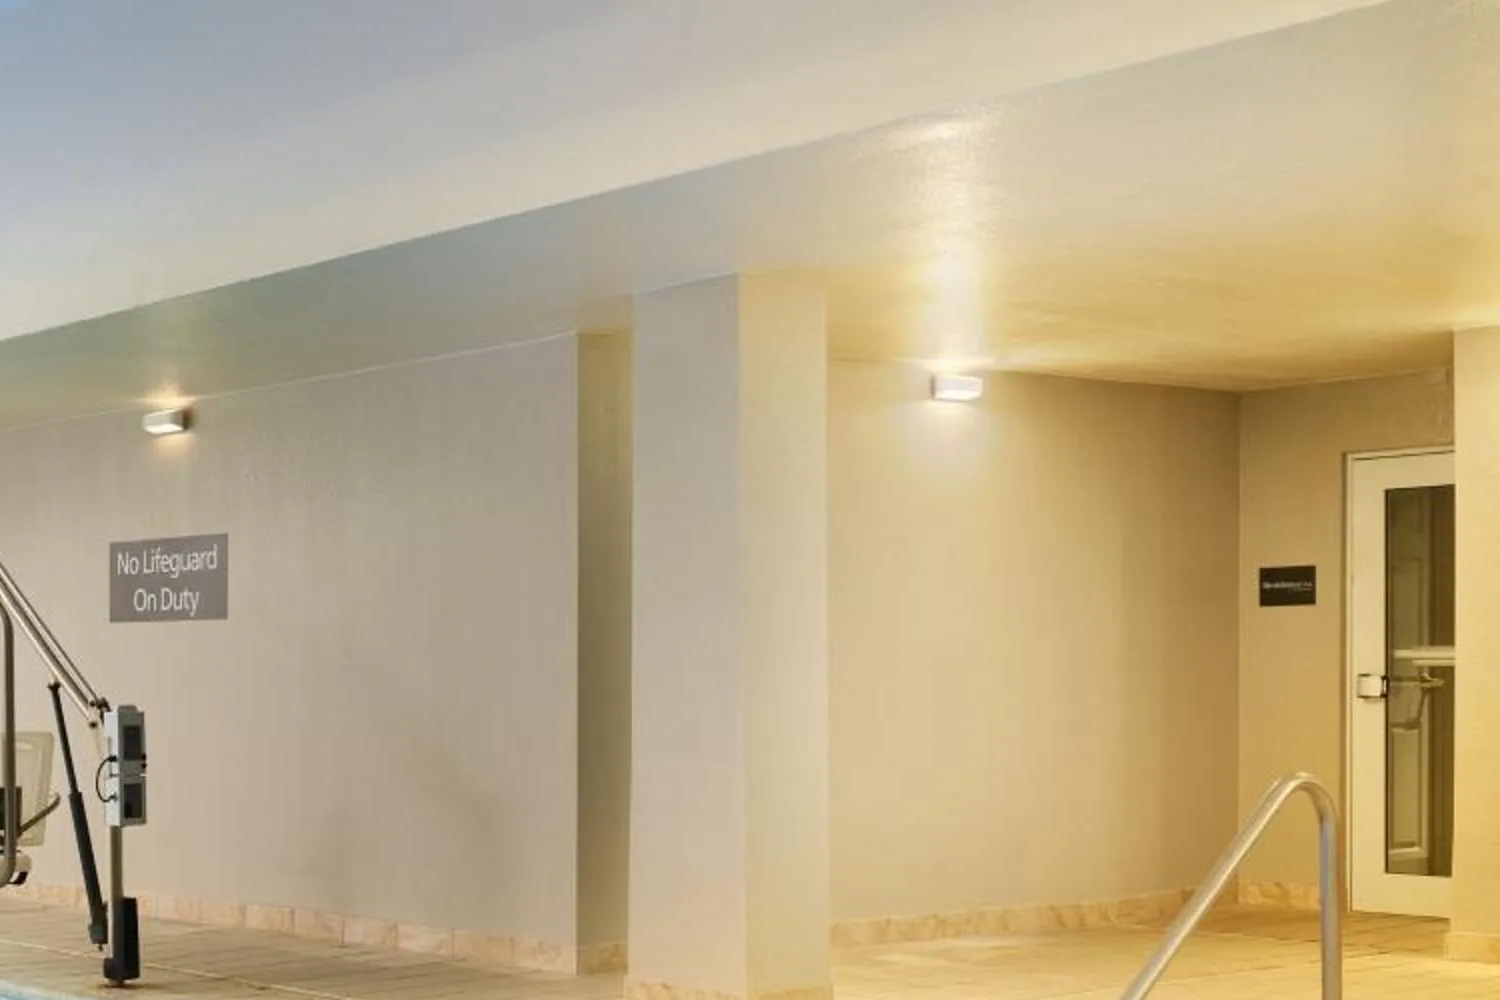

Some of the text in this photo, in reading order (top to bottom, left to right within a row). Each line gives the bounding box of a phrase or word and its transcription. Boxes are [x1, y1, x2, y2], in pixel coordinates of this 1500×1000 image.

[117, 544, 217, 578] No Lifeguard
[133, 587, 199, 617] On Duty
